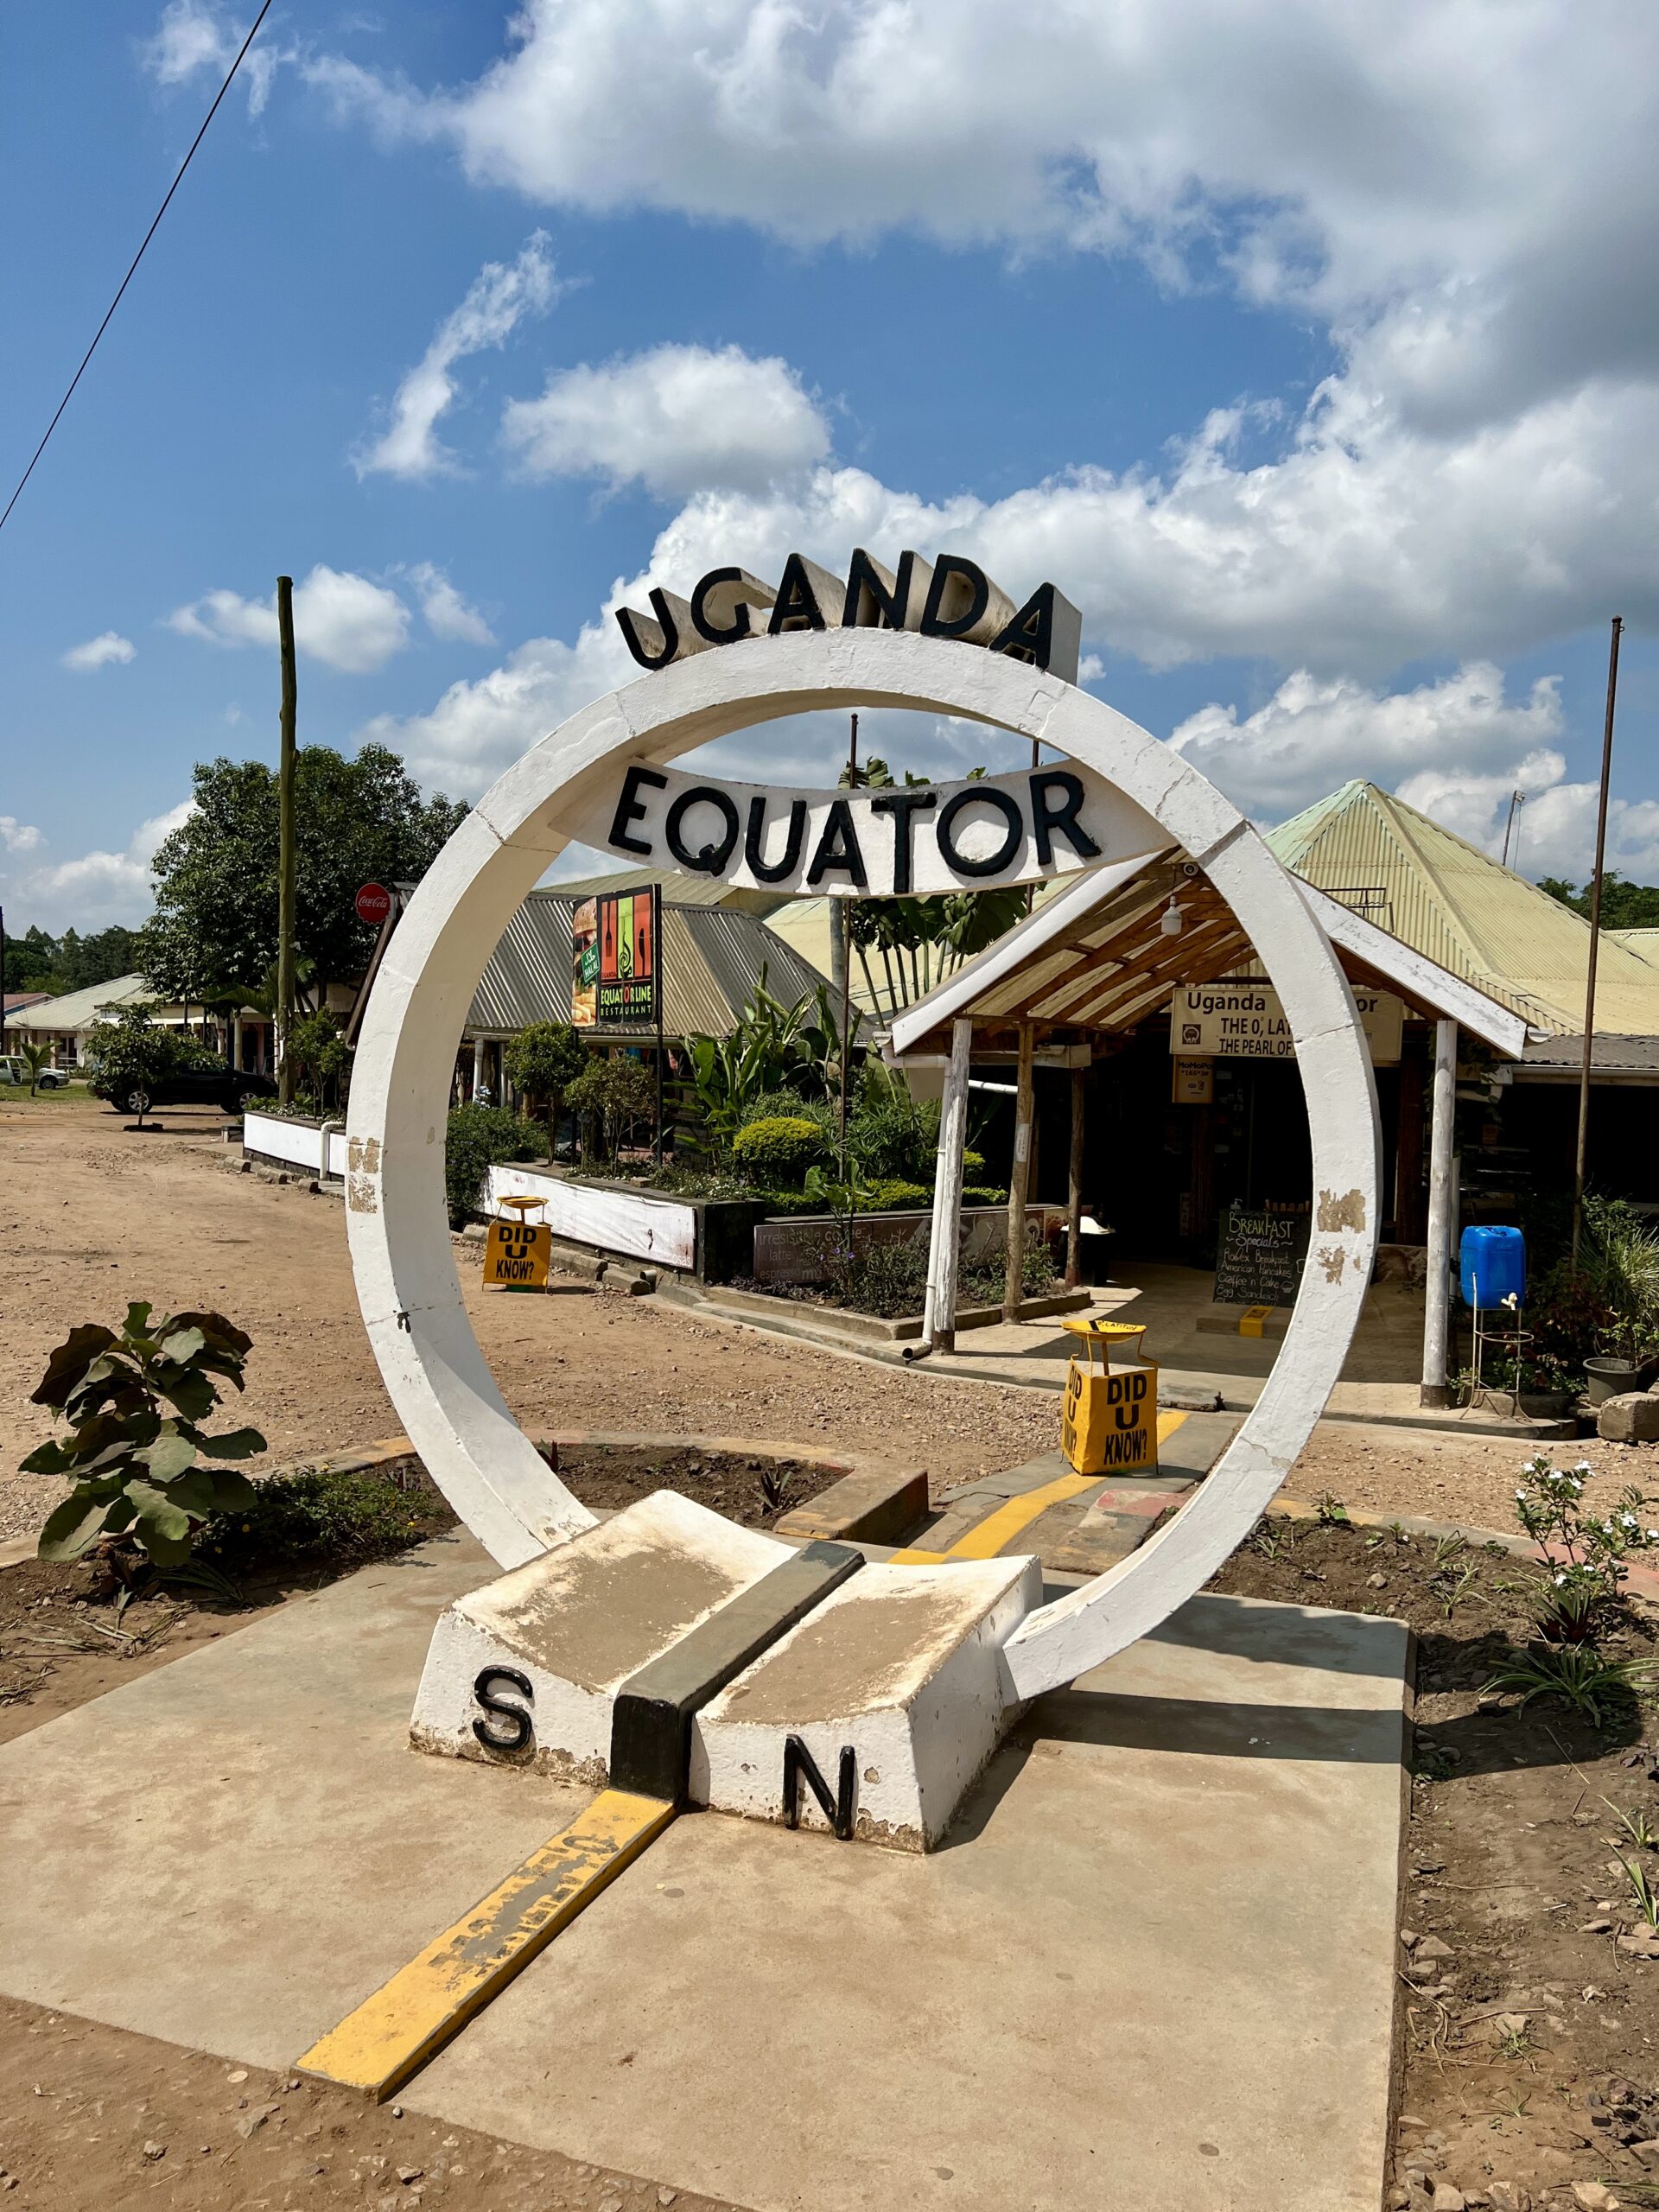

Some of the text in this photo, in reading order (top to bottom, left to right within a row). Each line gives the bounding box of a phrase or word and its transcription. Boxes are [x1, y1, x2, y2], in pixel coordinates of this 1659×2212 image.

[615, 548, 1055, 672] UGANDA
[608, 766, 1102, 893] EQUATOR
[584, 960, 599, 978] HALAL
[600, 1005, 652, 1017] RESTAURANT
[1187, 992, 1266, 1014] Uganda
[1221, 1017, 1247, 1034] THE
[1219, 1039, 1293, 1055] THE PEARL OF
[499, 1226, 537, 1244] DID
[505, 1244, 528, 1259] U
[769, 1249, 791, 1261] latte
[496, 1260, 535, 1280] KNOW?
[760, 1268, 802, 1279] espresso
[1220, 1260, 1292, 1278] American Pancakes
[1218, 1272, 1248, 1287] Coffee
[1260, 1275, 1279, 1288] Cake
[1217, 1284, 1234, 1298] Egg
[1107, 1374, 1147, 1405] DID
[1068, 1395, 1077, 1422] U
[1116, 1404, 1139, 1431] U
[1103, 1428, 1147, 1465] KNOW?
[473, 1664, 534, 1751] S
[784, 1733, 856, 1841] N
